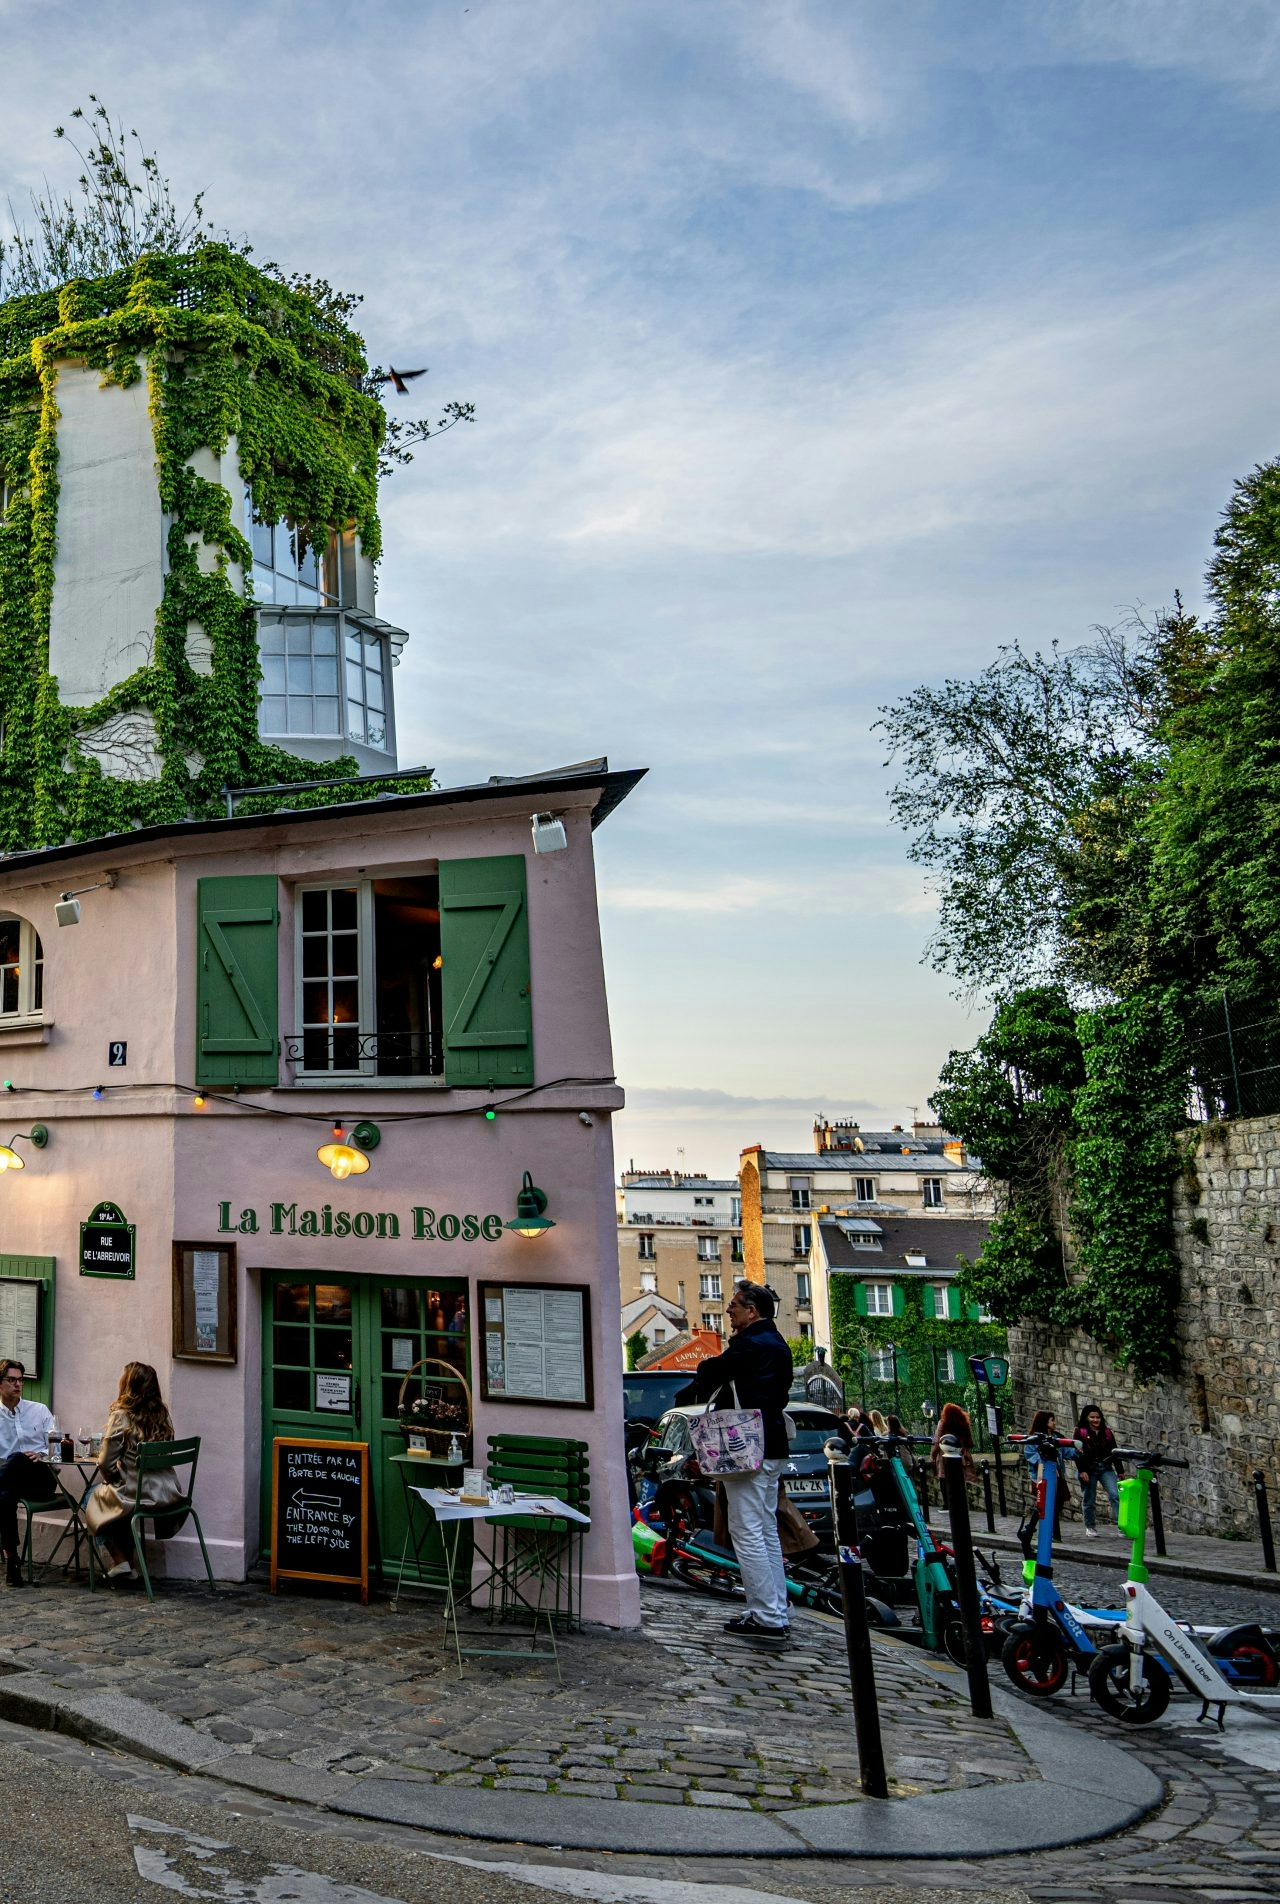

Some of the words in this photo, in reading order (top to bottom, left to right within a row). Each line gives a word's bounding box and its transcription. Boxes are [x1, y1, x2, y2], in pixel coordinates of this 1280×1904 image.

[113, 1043, 123, 1065] 2
[217, 1201, 260, 1235] La
[269, 1203, 401, 1239] Maison
[411, 1206, 503, 1241] Rose
[100, 1236, 113, 1246] RUE
[83, 1250, 92, 1260] DE
[92, 1251, 130, 1262] L'ABREUVOIR
[675, 1352, 698, 1363] LAPIN
[706, 1416, 724, 1427] Paris
[287, 1453, 323, 1464] ENTRÉE
[326, 1456, 343, 1466] PAR
[345, 1458, 357, 1468] LA
[288, 1467, 313, 1478] PORTE
[315, 1470, 327, 1479] DE
[330, 1472, 360, 1485] GAUCHE
[286, 1507, 340, 1522] ENTRANCE
[342, 1514, 356, 1528] BY
[286, 1524, 305, 1533] THE
[306, 1524, 330, 1534] DOOR
[332, 1528, 344, 1538] ON
[286, 1535, 303, 1544] THE
[304, 1536, 328, 1546] LEFT
[1063, 1612, 1083, 1637] dott
[1164, 1629, 1175, 1642] On
[1173, 1640, 1191, 1659] Lime
[1194, 1663, 1212, 1682] Uber
